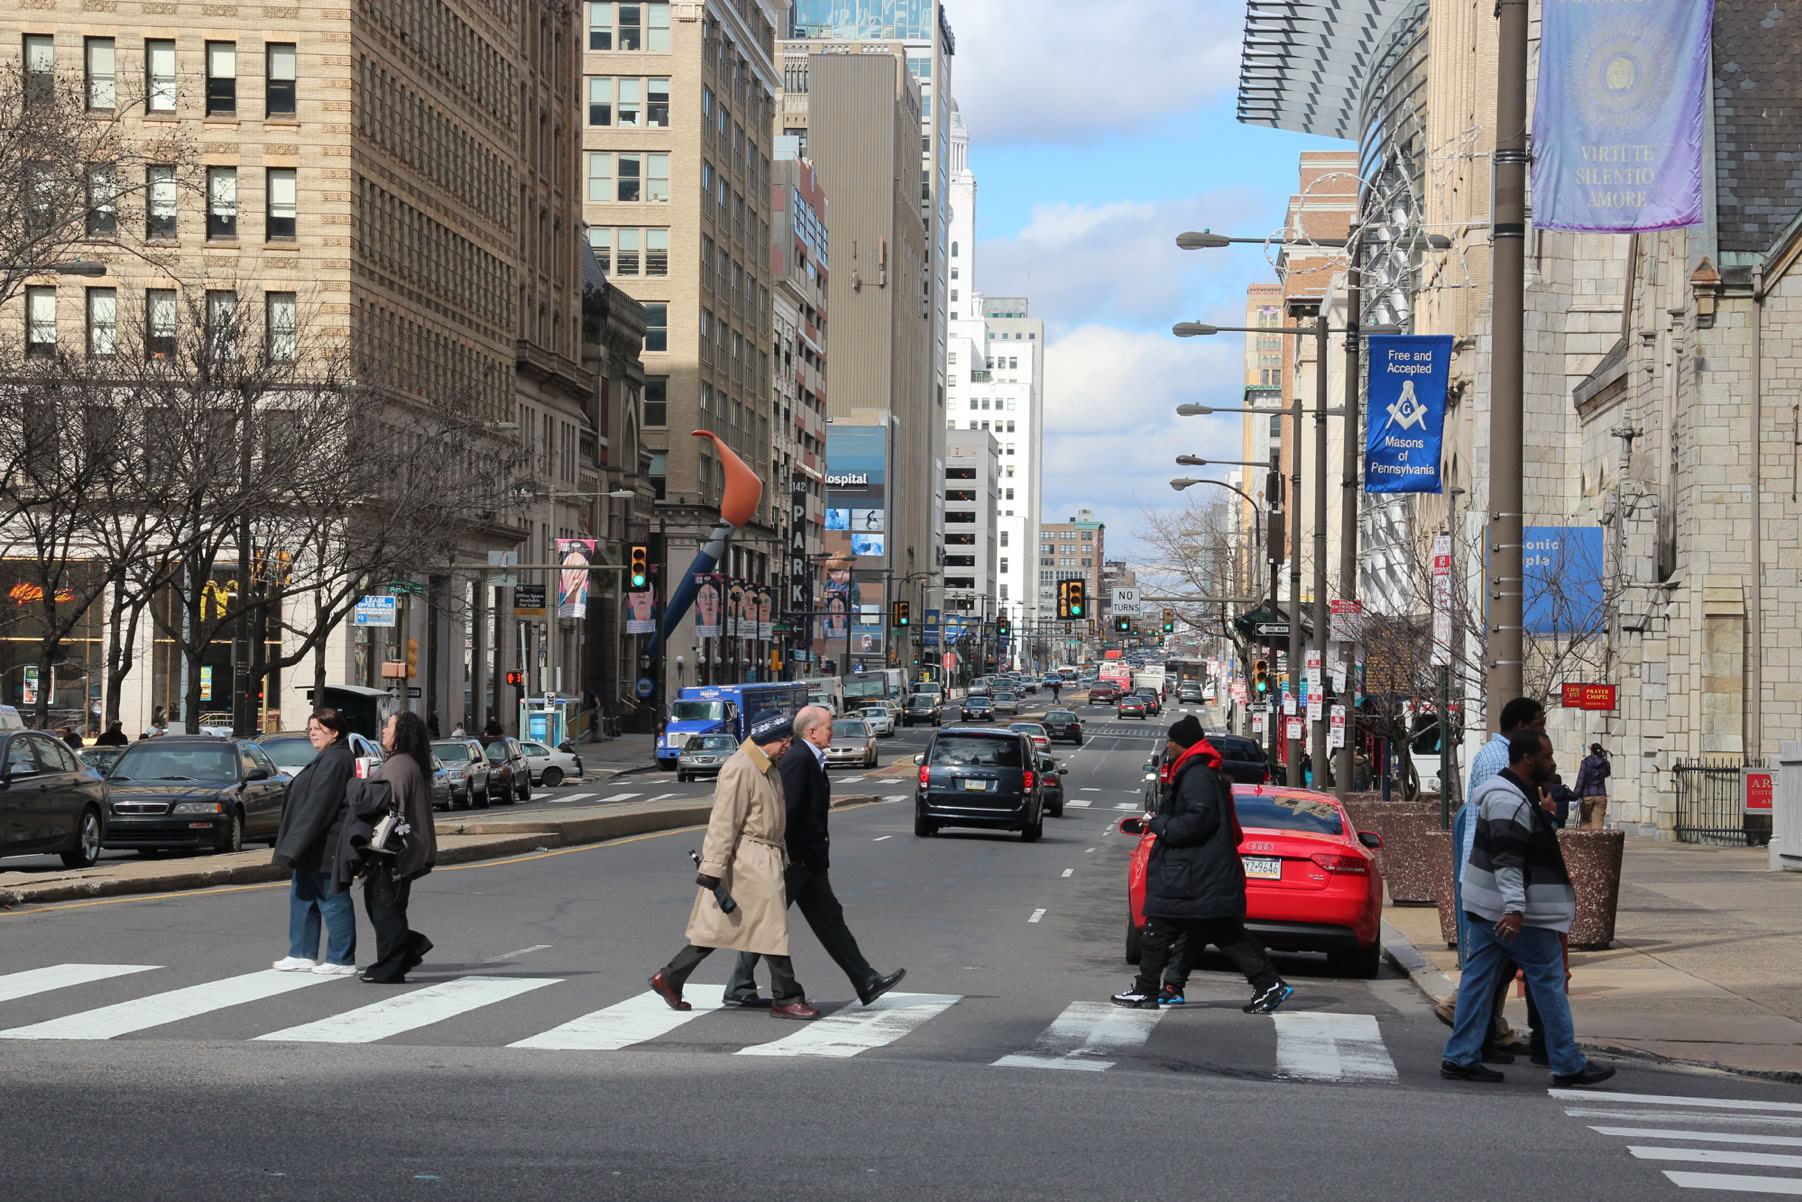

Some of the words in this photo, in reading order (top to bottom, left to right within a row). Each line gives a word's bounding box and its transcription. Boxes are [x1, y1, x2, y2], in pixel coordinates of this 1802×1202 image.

[1581, 144, 1655, 162] VIRTUTE
[1576, 168, 1655, 185] SILENTIO
[1588, 191, 1648, 208] AMORE
[1388, 350, 1410, 361] Free
[1413, 350, 1432, 361] and
[1387, 363, 1432, 376] Accepted
[1402, 402, 1411, 414] G
[1385, 436, 1424, 448] Masons
[1398, 451, 1409, 461] of
[1371, 462, 1434, 477] Pennsylvania
[792, 481, 806, 492] 142
[1522, 539, 1559, 550] onic
[793, 505, 804, 602] PARK
[1522, 555, 1550, 568] ple
[1119, 591, 1133, 600] NO
